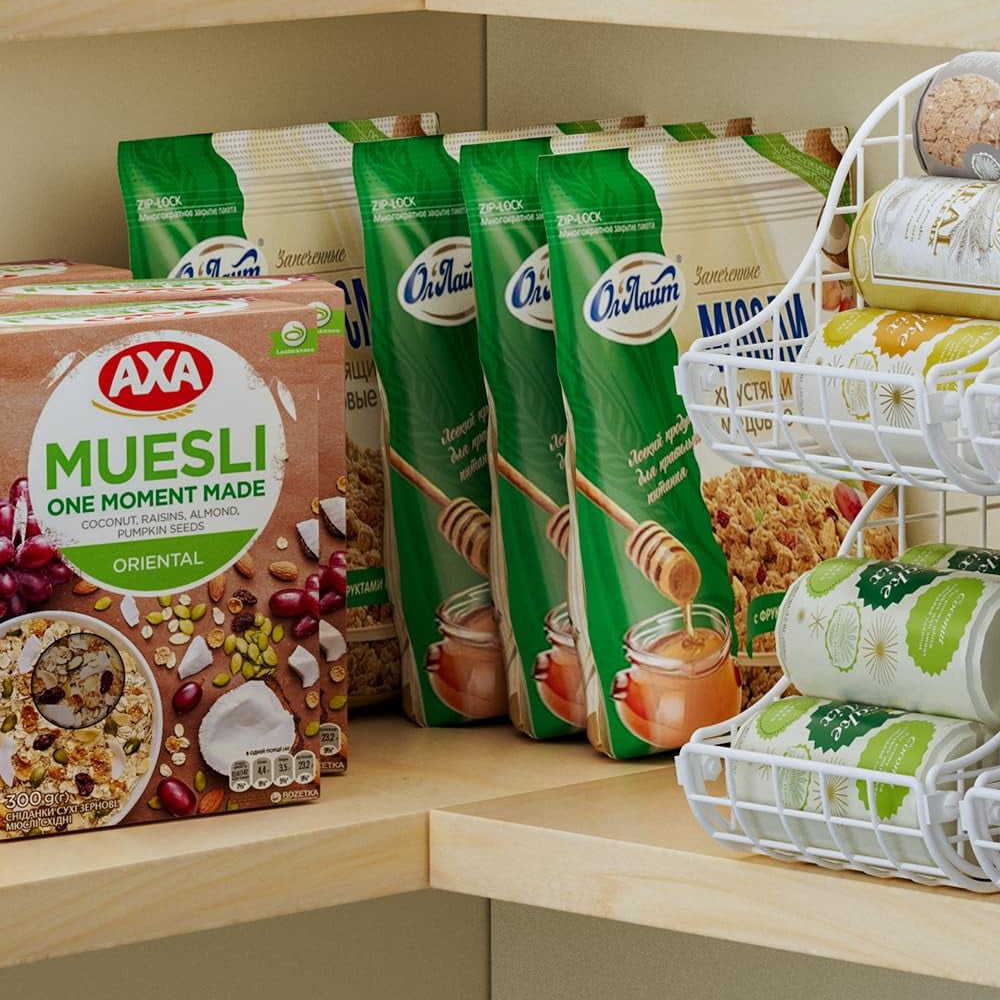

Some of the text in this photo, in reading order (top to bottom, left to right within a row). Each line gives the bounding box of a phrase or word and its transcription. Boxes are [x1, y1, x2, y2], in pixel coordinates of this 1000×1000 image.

[137, 195, 182, 211] ZIP-LOCK
[371, 196, 416, 212] ZIP-LOCK
[478, 199, 524, 215] ZIP-LOCK
[556, 211, 602, 226] ZIP-LOCK
[276, 248, 347, 269] Запеченные
[693, 263, 761, 286] Запеченные
[108, 349, 203, 398] AXA
[45, 424, 266, 491] MUESLI
[47, 479, 266, 517] ONE MOMENT MADE
[117, 521, 205, 539] PUMPKIN SEEDS
[113, 551, 204, 574] ORIENTAL
[6, 791, 42, 809] 300
[282, 789, 319, 799] ROZETKA
[5, 808, 55, 821] СНІДАНКИ
[6, 815, 72, 832] МЮСЛІ СХІДНІ
